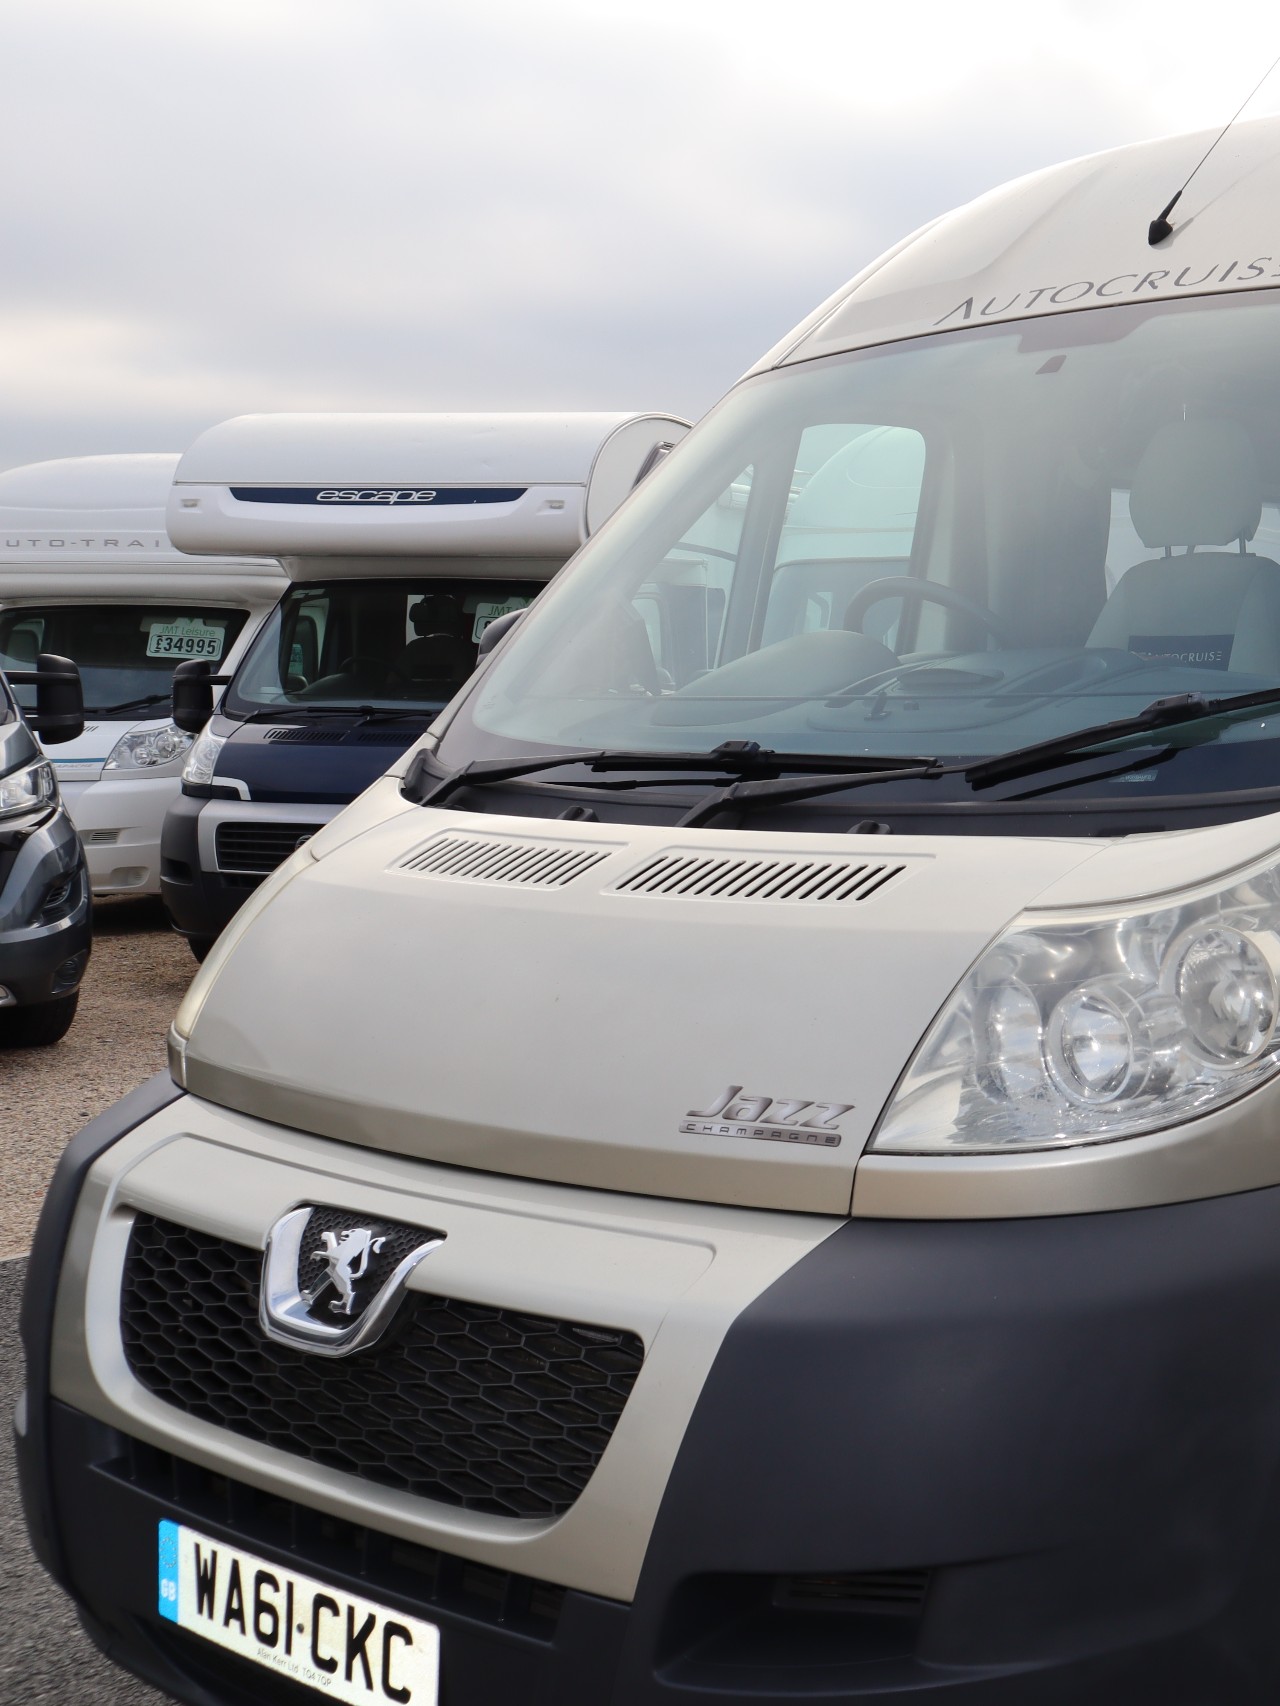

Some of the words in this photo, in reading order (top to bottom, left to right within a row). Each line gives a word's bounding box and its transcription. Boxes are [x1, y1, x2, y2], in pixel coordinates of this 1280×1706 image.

[315, 489, 438, 505] escape
[5, 538, 175, 548] UTO-TRAI
[159, 625, 179, 635] JMT
[182, 627, 216, 637] Leisure
[153, 635, 217, 655] £34995
[685, 1085, 856, 1130] Jazz
[685, 1123, 837, 1144] CHAMPAGNE
[160, 1577, 177, 1602] GB
[193, 1542, 294, 1656] WA61
[310, 1592, 414, 1705] CKC
